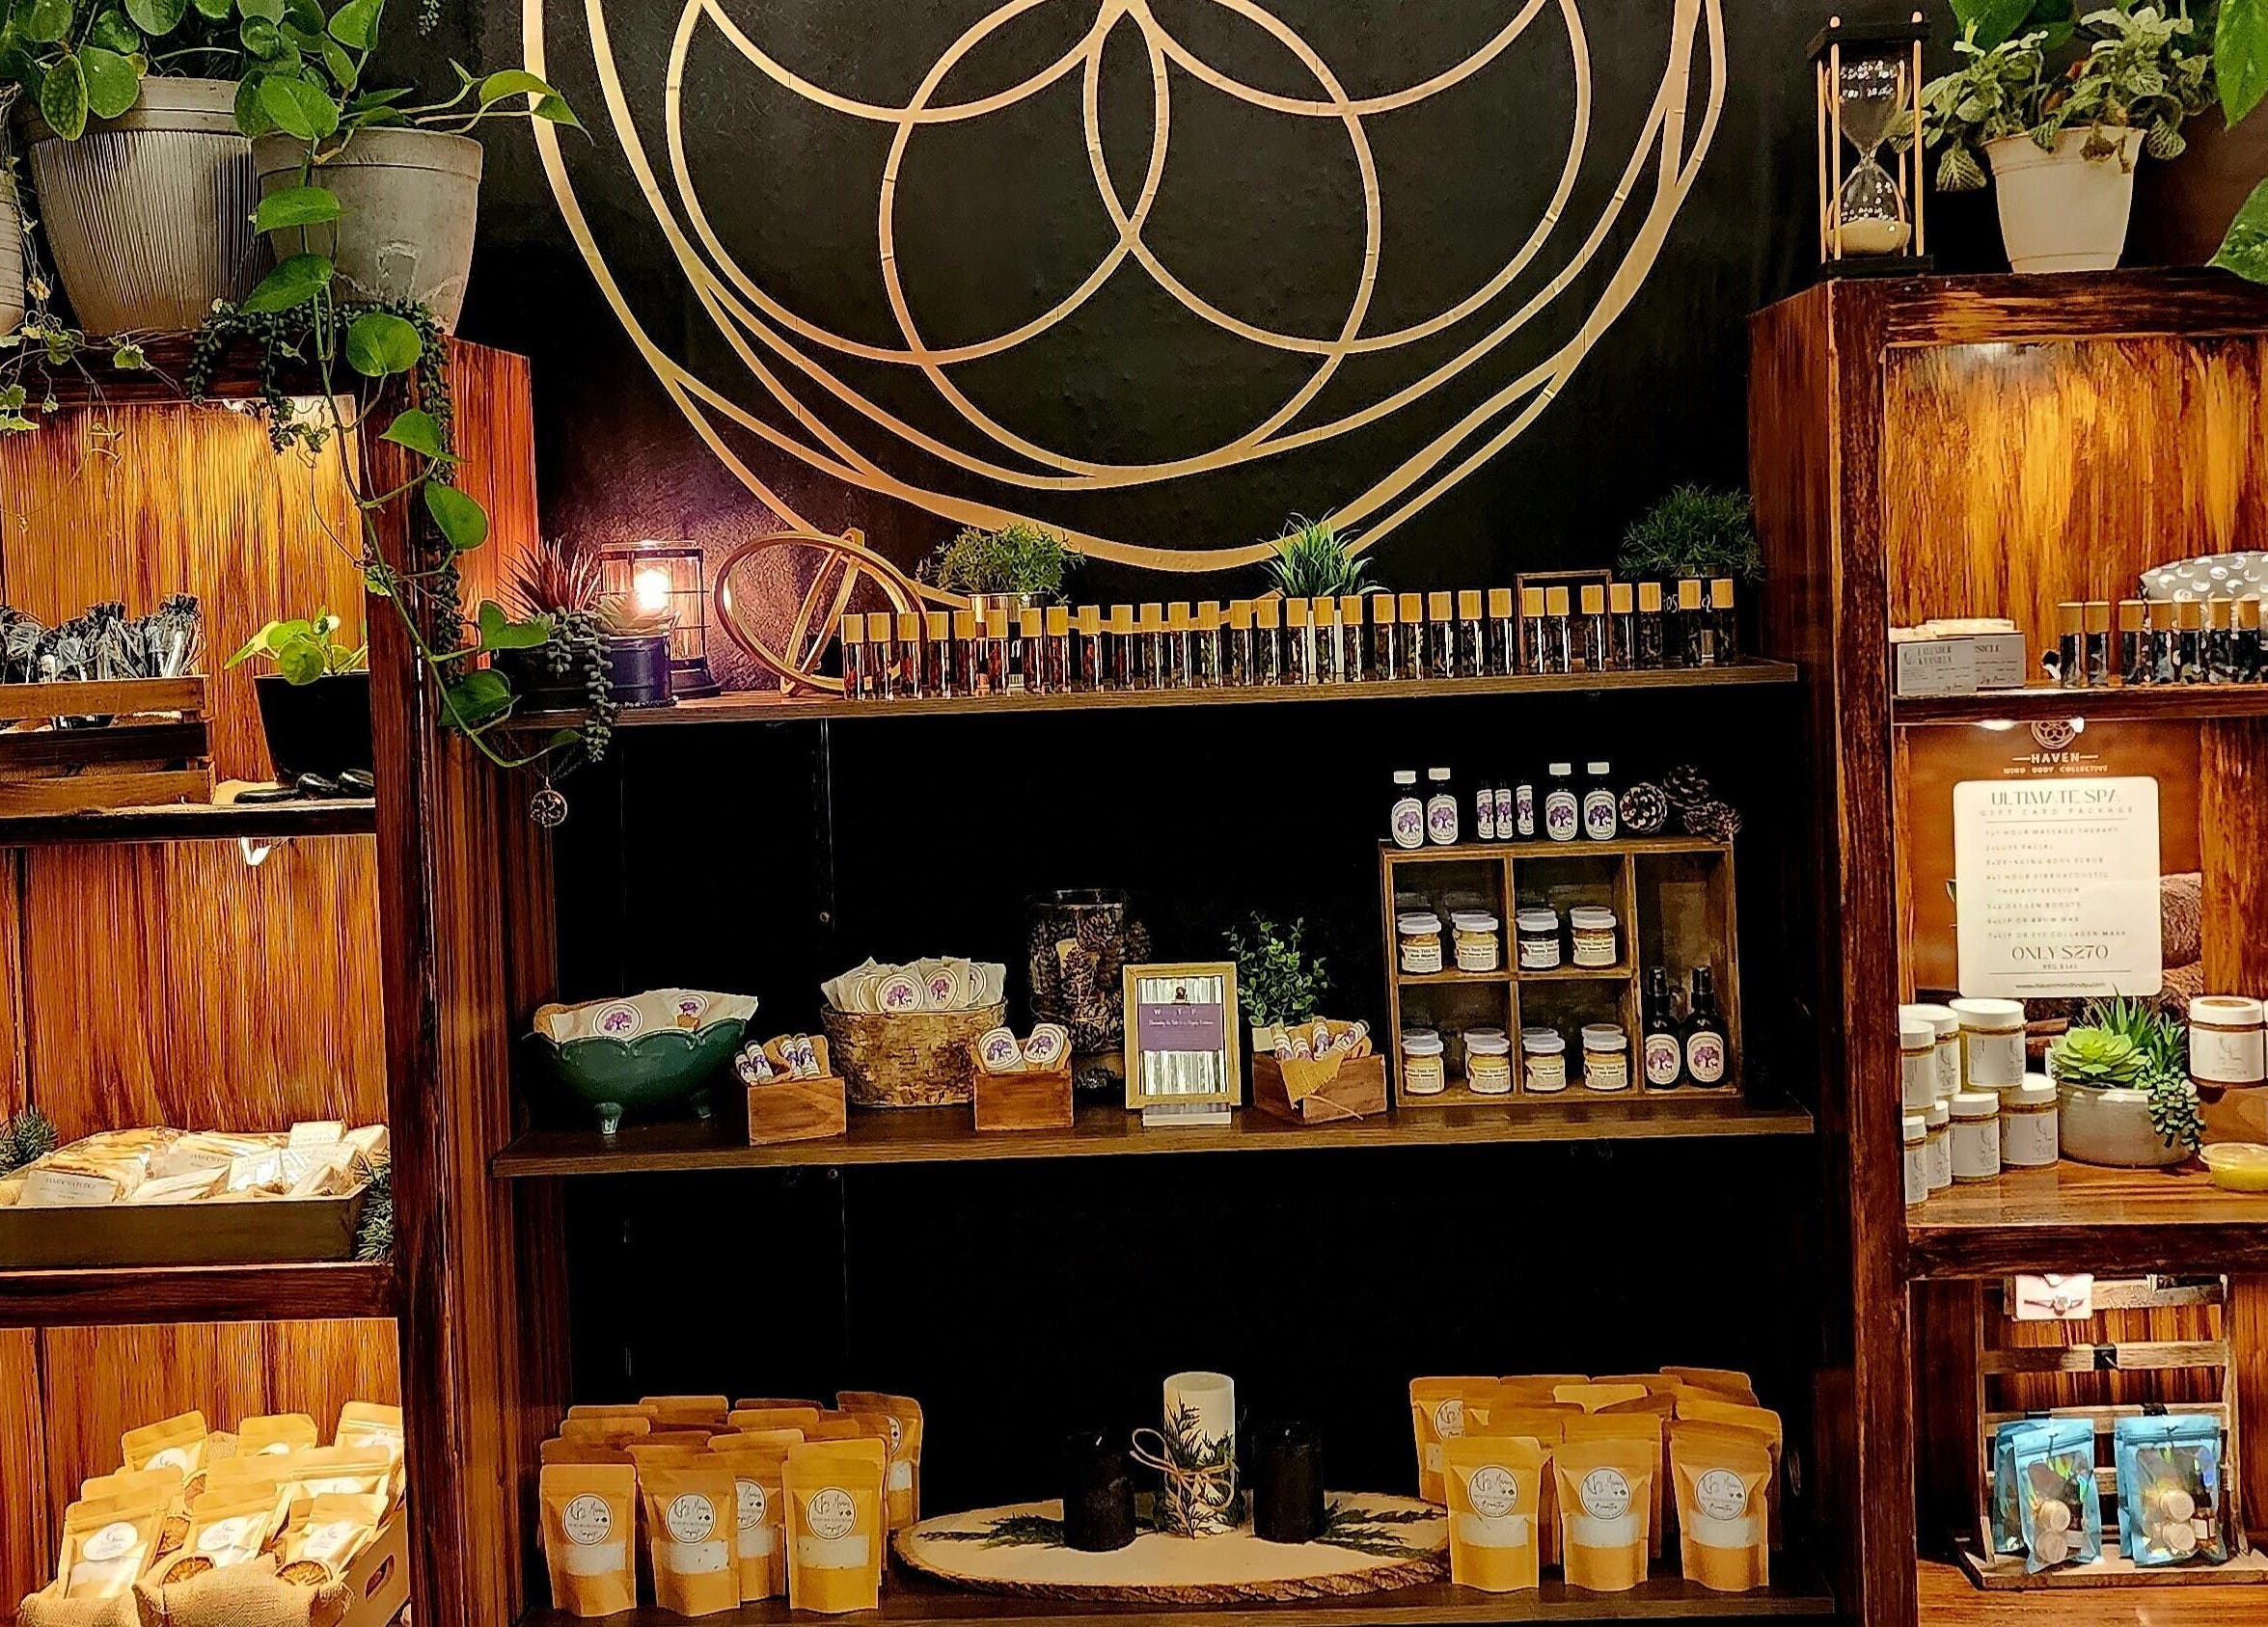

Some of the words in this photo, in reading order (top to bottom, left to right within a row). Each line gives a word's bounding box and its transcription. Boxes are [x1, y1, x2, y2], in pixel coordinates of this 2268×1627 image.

[2031, 752, 2080, 764] HAVEN
[1991, 789, 2080, 806] ULTIMATE
[2084, 788, 2120, 804] SPA
[2011, 945, 2057, 961] ONLY
